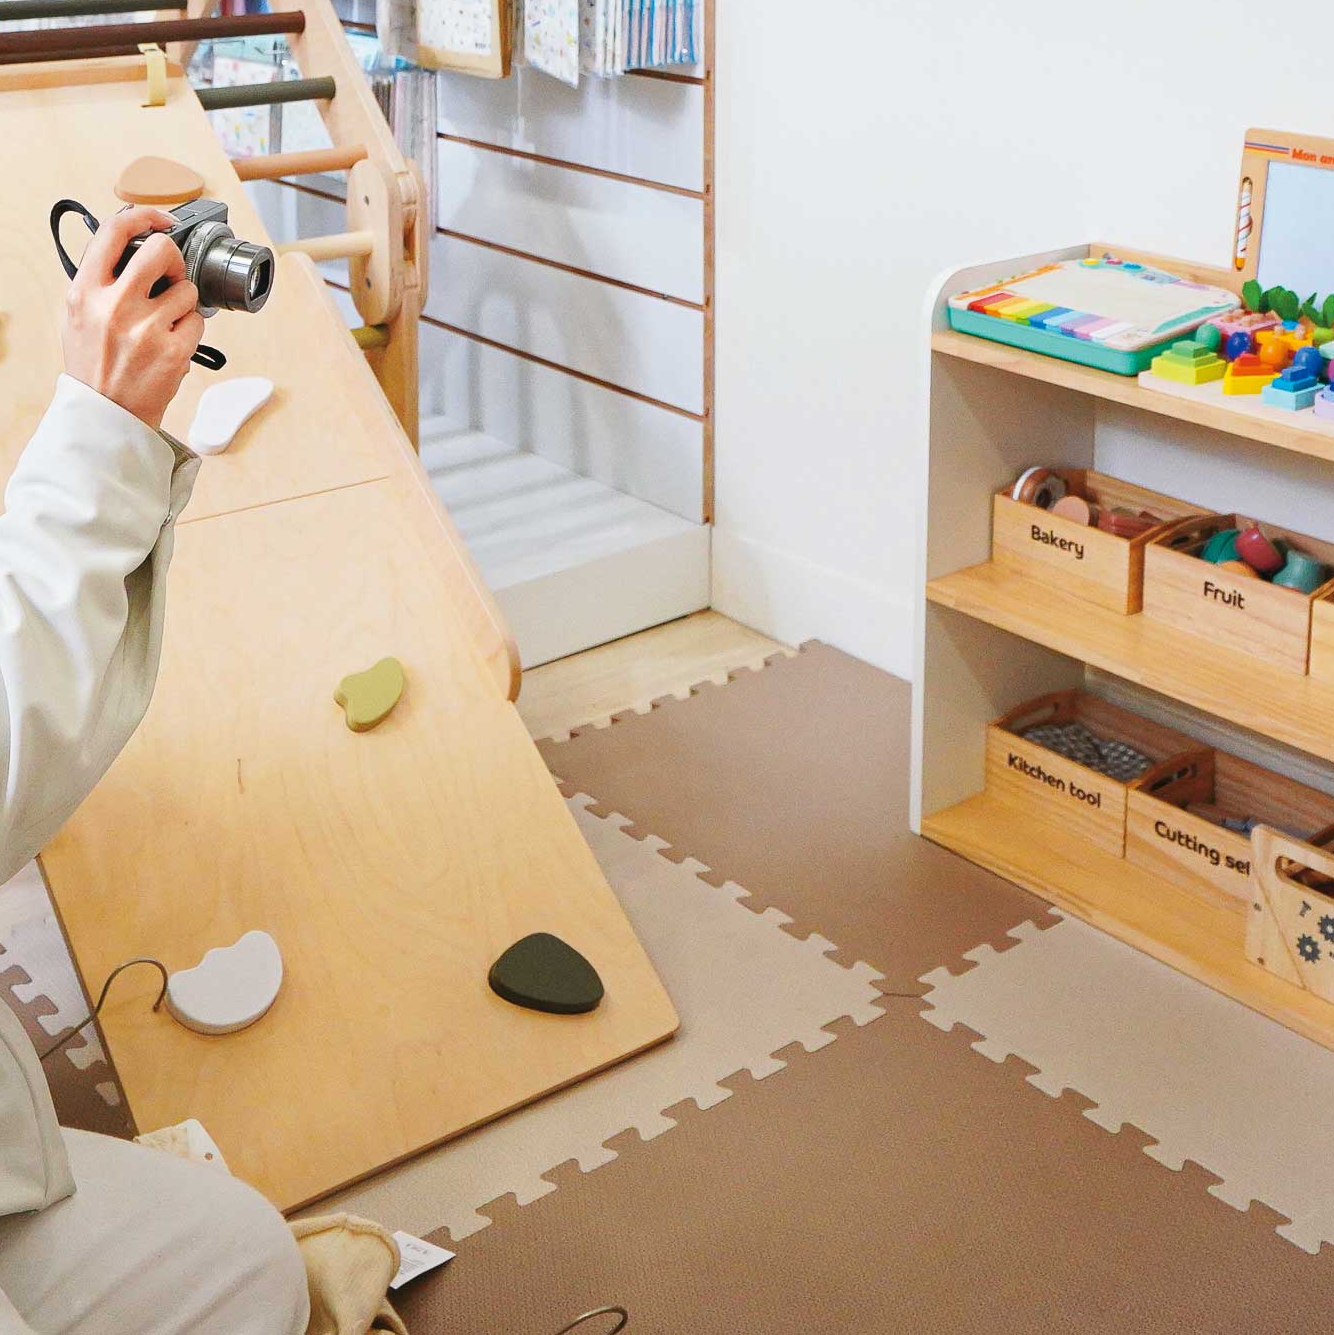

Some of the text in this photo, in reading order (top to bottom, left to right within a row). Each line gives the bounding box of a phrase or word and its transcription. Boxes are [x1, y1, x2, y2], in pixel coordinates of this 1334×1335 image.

[1291, 147, 1317, 163] Mon
[1031, 524, 1085, 560] Bakery
[1203, 580, 1246, 610] Fruit
[1008, 752, 1101, 809] Kitchen tool
[1154, 820, 1220, 866] Cutting
